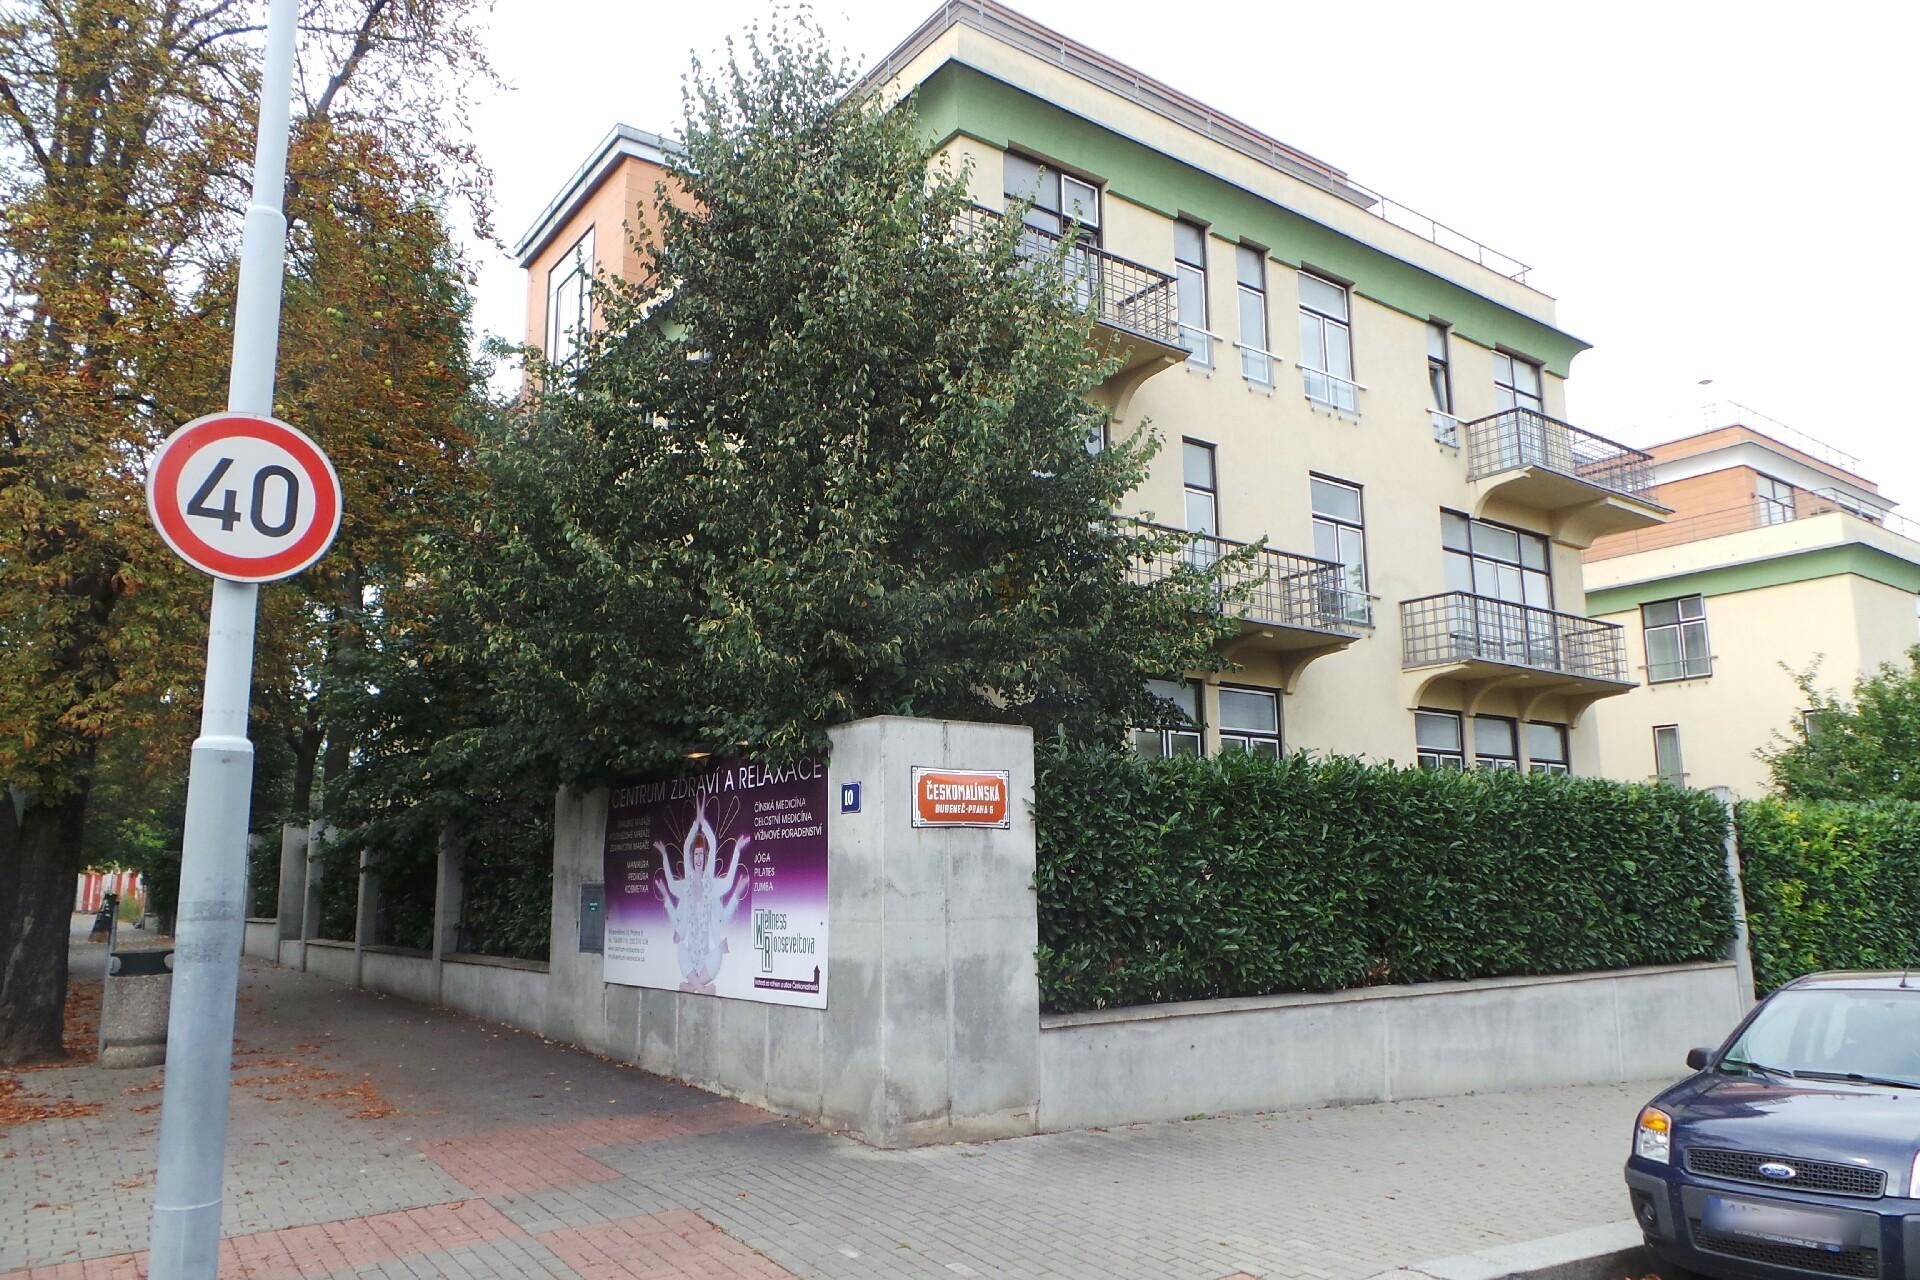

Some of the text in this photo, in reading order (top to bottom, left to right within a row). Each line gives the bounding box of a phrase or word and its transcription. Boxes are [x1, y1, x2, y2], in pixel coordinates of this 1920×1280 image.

[187, 457, 300, 538] 40
[611, 757, 822, 809] CENTRUM ZDRAVÍ A RELAXACE
[926, 781, 1000, 802] ČESKOMALÍNSKÁ
[754, 796, 806, 812] ČÍNSKÁ MEDICÍNA
[845, 789, 854, 806] 10
[989, 805, 994, 814] 6
[754, 810, 812, 827] CELOSTNÍ MEDICÍNA
[754, 824, 822, 841] VÝŽIVOVÉ PORADENSTVÍ
[754, 851, 771, 864] JÓGA
[754, 867, 775, 877] PILATES
[754, 882, 774, 892] ZUMBA
[756, 910, 787, 946] Wellness
[764, 933, 816, 969] Rooseveltova
